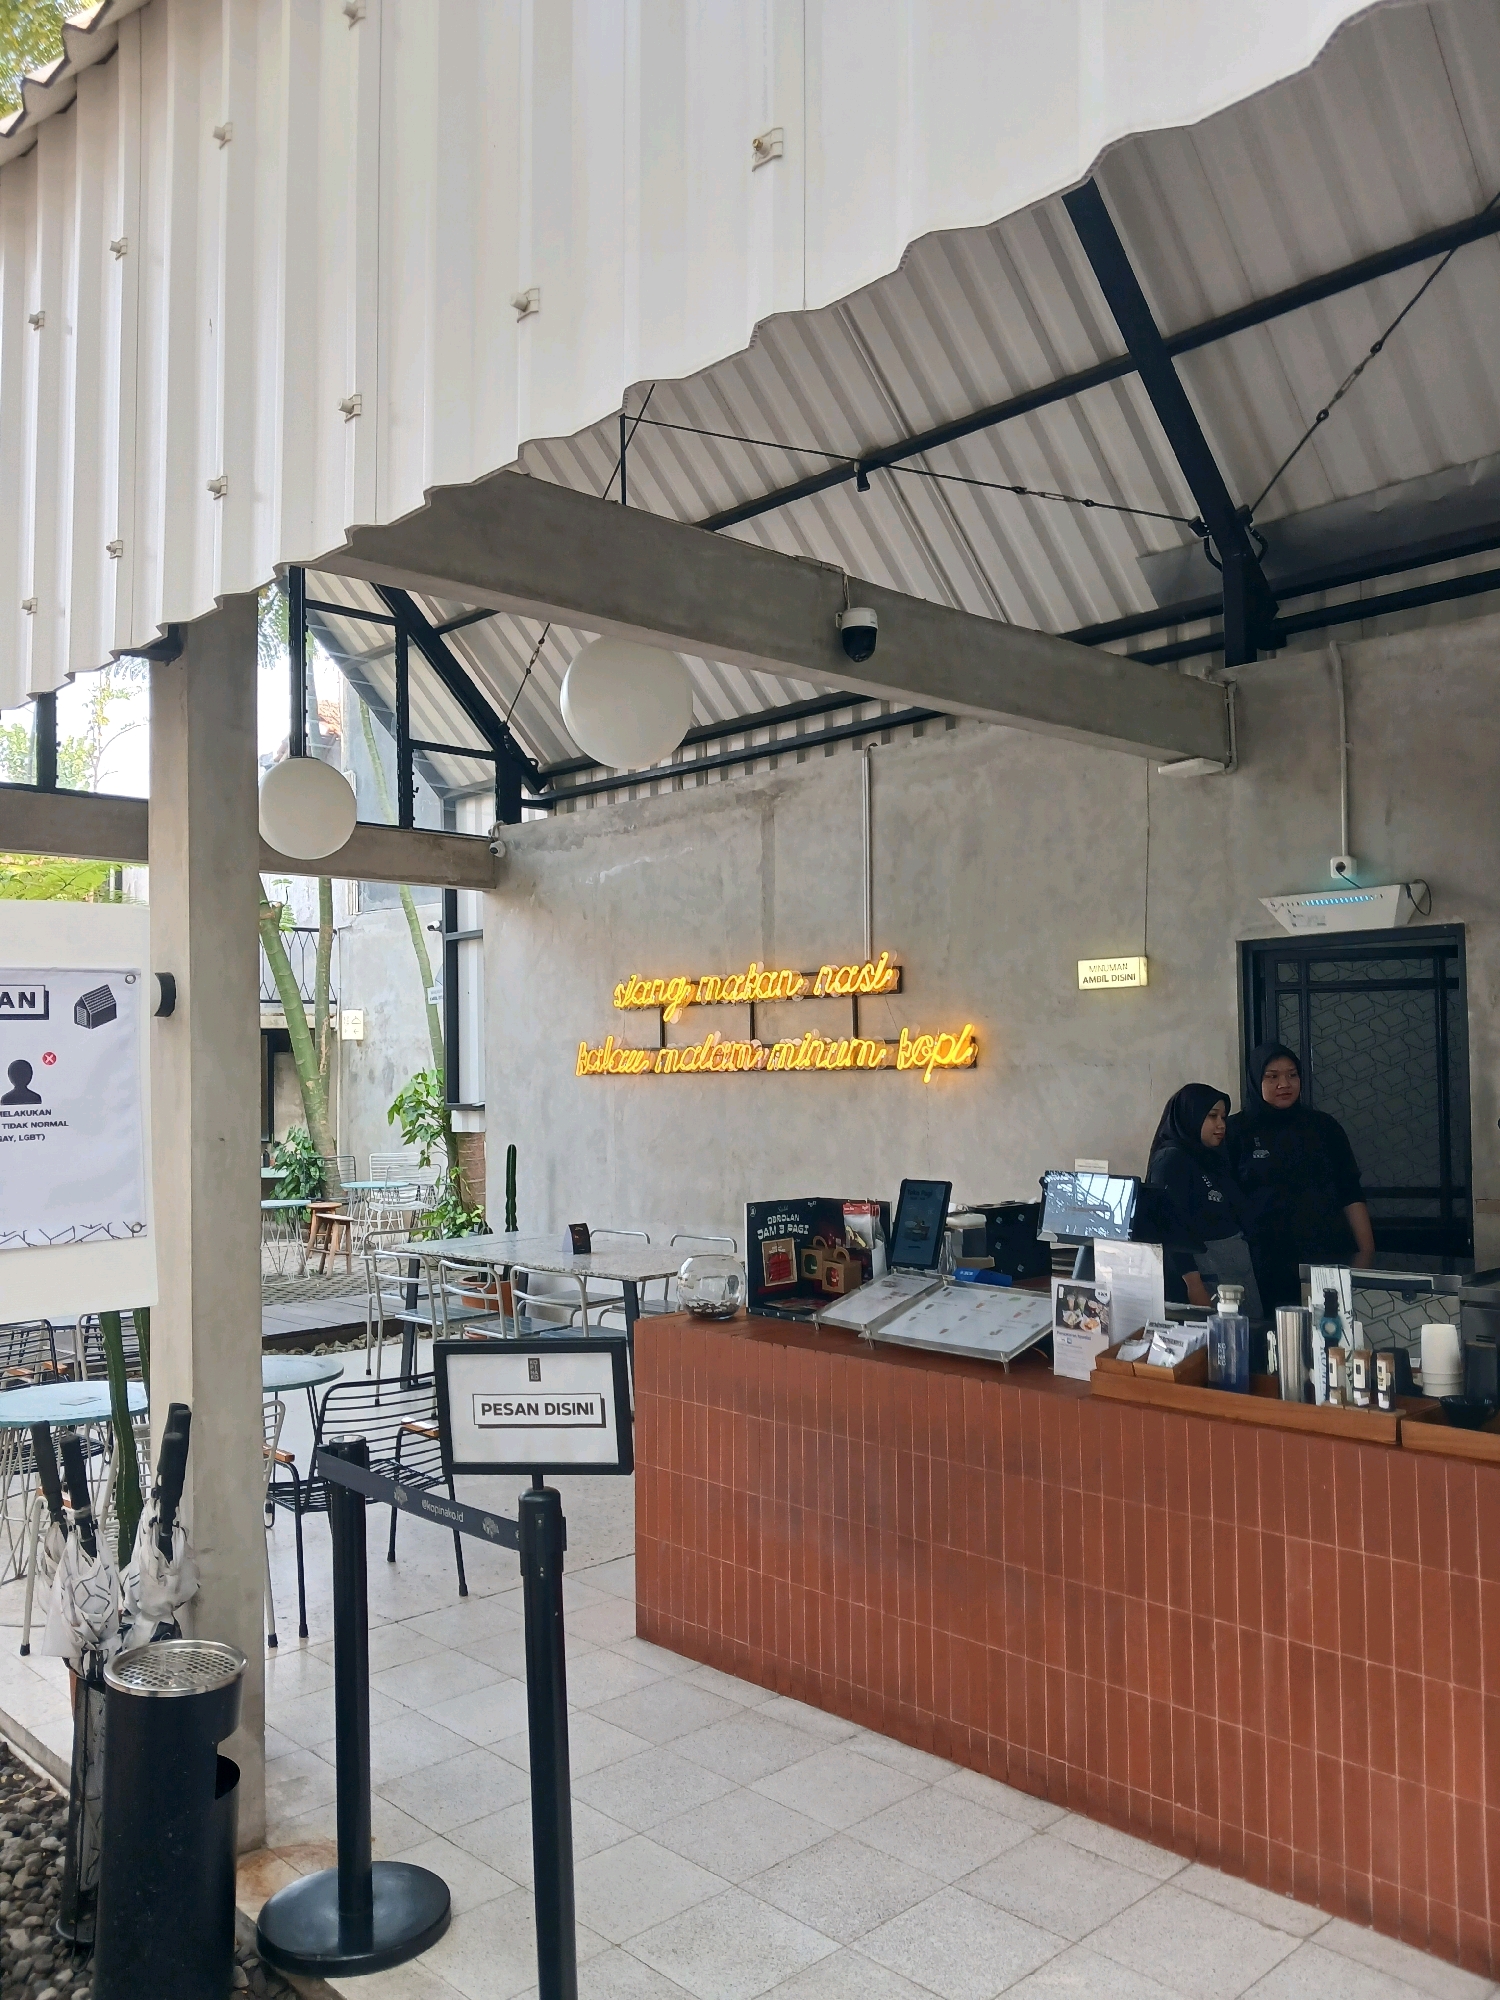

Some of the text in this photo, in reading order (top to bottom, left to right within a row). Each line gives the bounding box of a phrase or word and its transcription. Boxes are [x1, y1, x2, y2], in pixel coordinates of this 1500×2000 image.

[1082, 973, 1136, 984] AMBIL DISINI
[613, 951, 893, 1022] siang makan nasi
[576, 1023, 972, 1083] kalau malam minum kopi
[19, 1133, 46, 1141] LGBT)
[767, 1213, 800, 1224] OBROLAN
[757, 1223, 809, 1240] JAM 3 PAGI
[481, 1402, 594, 1416] PESAN DISINI
[421, 1499, 464, 1523] @kopinako.id
